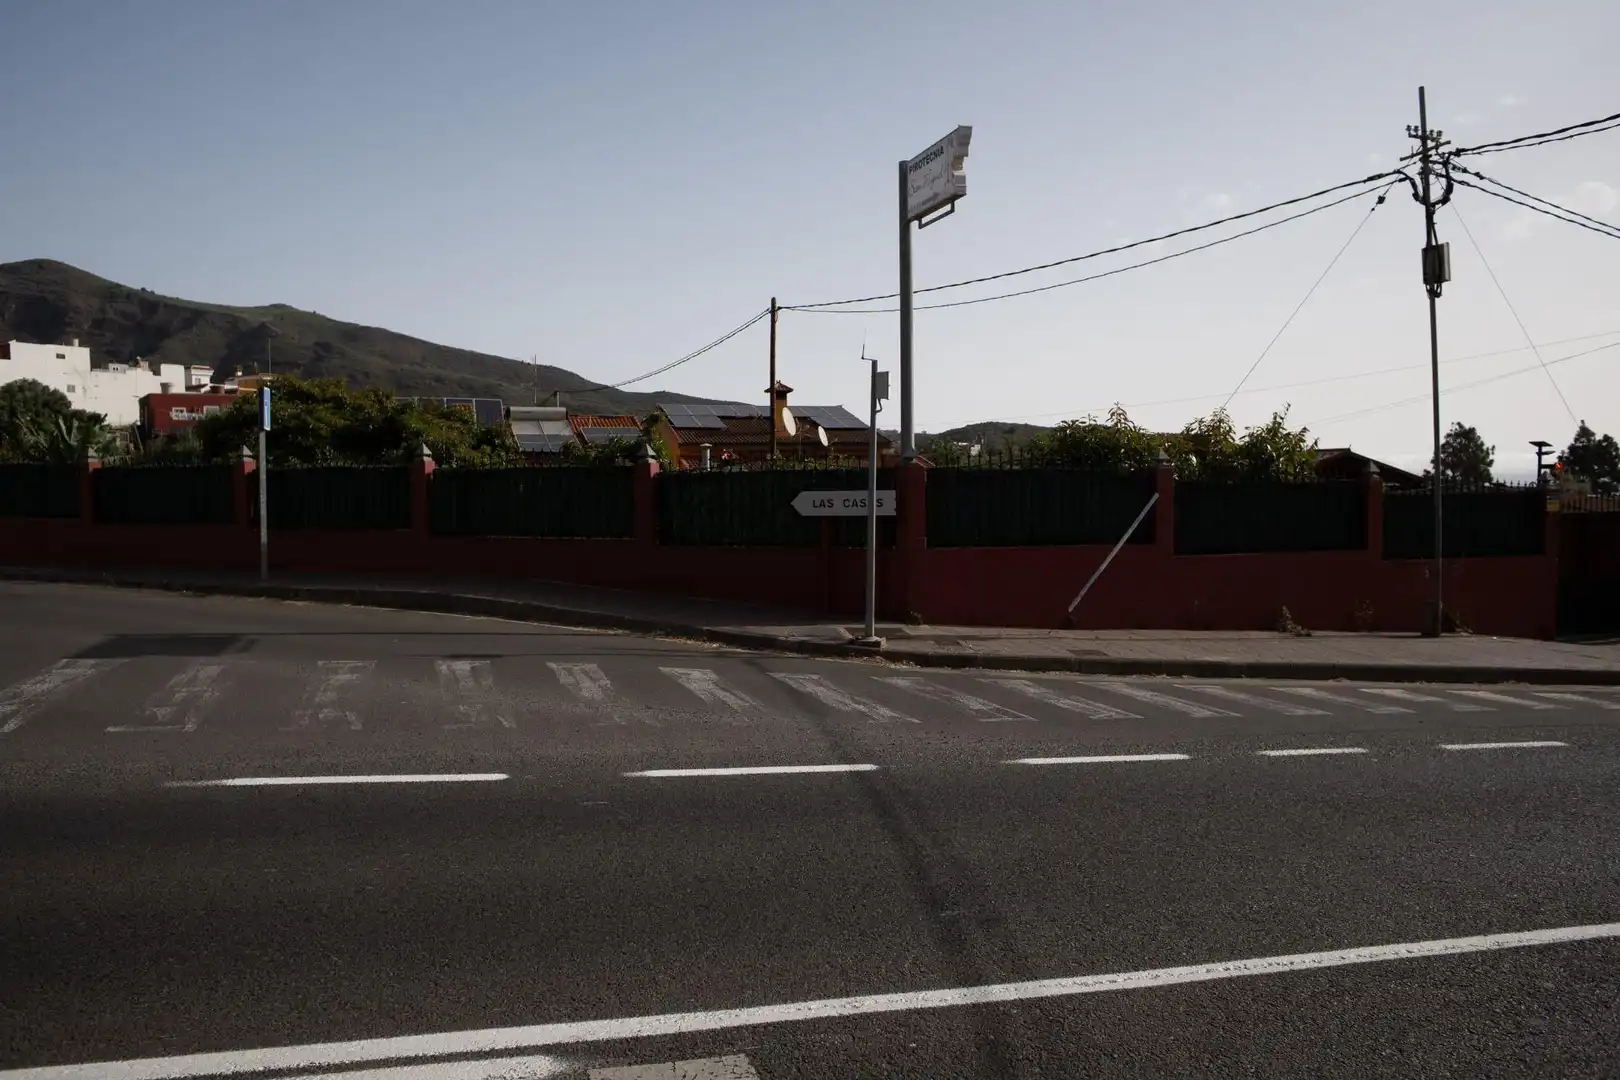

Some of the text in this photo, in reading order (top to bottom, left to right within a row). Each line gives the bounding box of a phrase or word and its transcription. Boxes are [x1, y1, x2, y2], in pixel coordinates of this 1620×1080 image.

[909, 146, 944, 174] PIROTECNIA
[812, 498, 884, 509] LAS CASS
